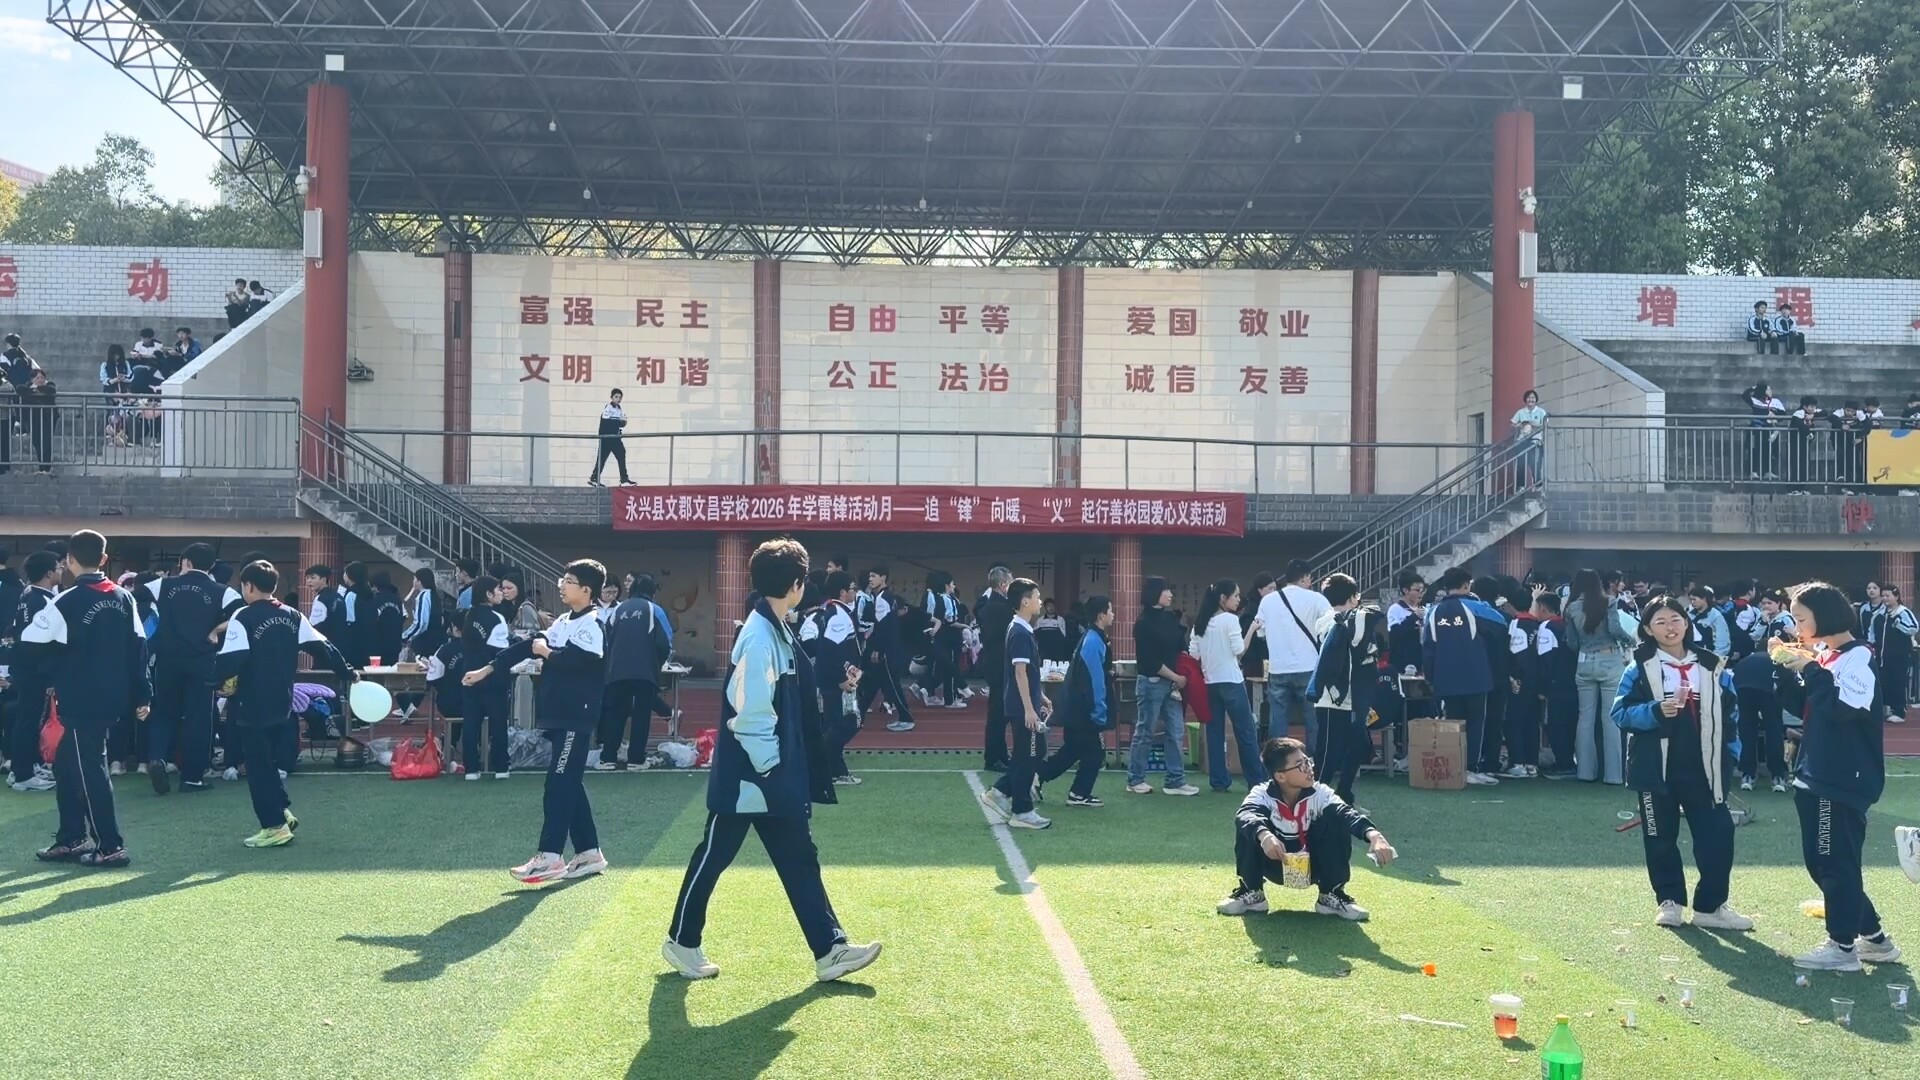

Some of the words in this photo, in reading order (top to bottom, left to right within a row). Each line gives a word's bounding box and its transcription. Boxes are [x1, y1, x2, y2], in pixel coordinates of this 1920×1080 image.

[519, 295, 595, 327] 富强
[636, 298, 709, 329] 民主
[828, 303, 897, 333] 自由
[938, 304, 1011, 335] 平等
[1126, 306, 1197, 337] 爱国
[1239, 308, 1310, 338] 敬业
[519, 353, 592, 384] 文明
[636, 356, 709, 387] 和谐
[826, 360, 898, 390] 公正
[938, 362, 1010, 392] 法治
[1124, 364, 1196, 394] 诚信
[1239, 365, 1309, 395] 友善
